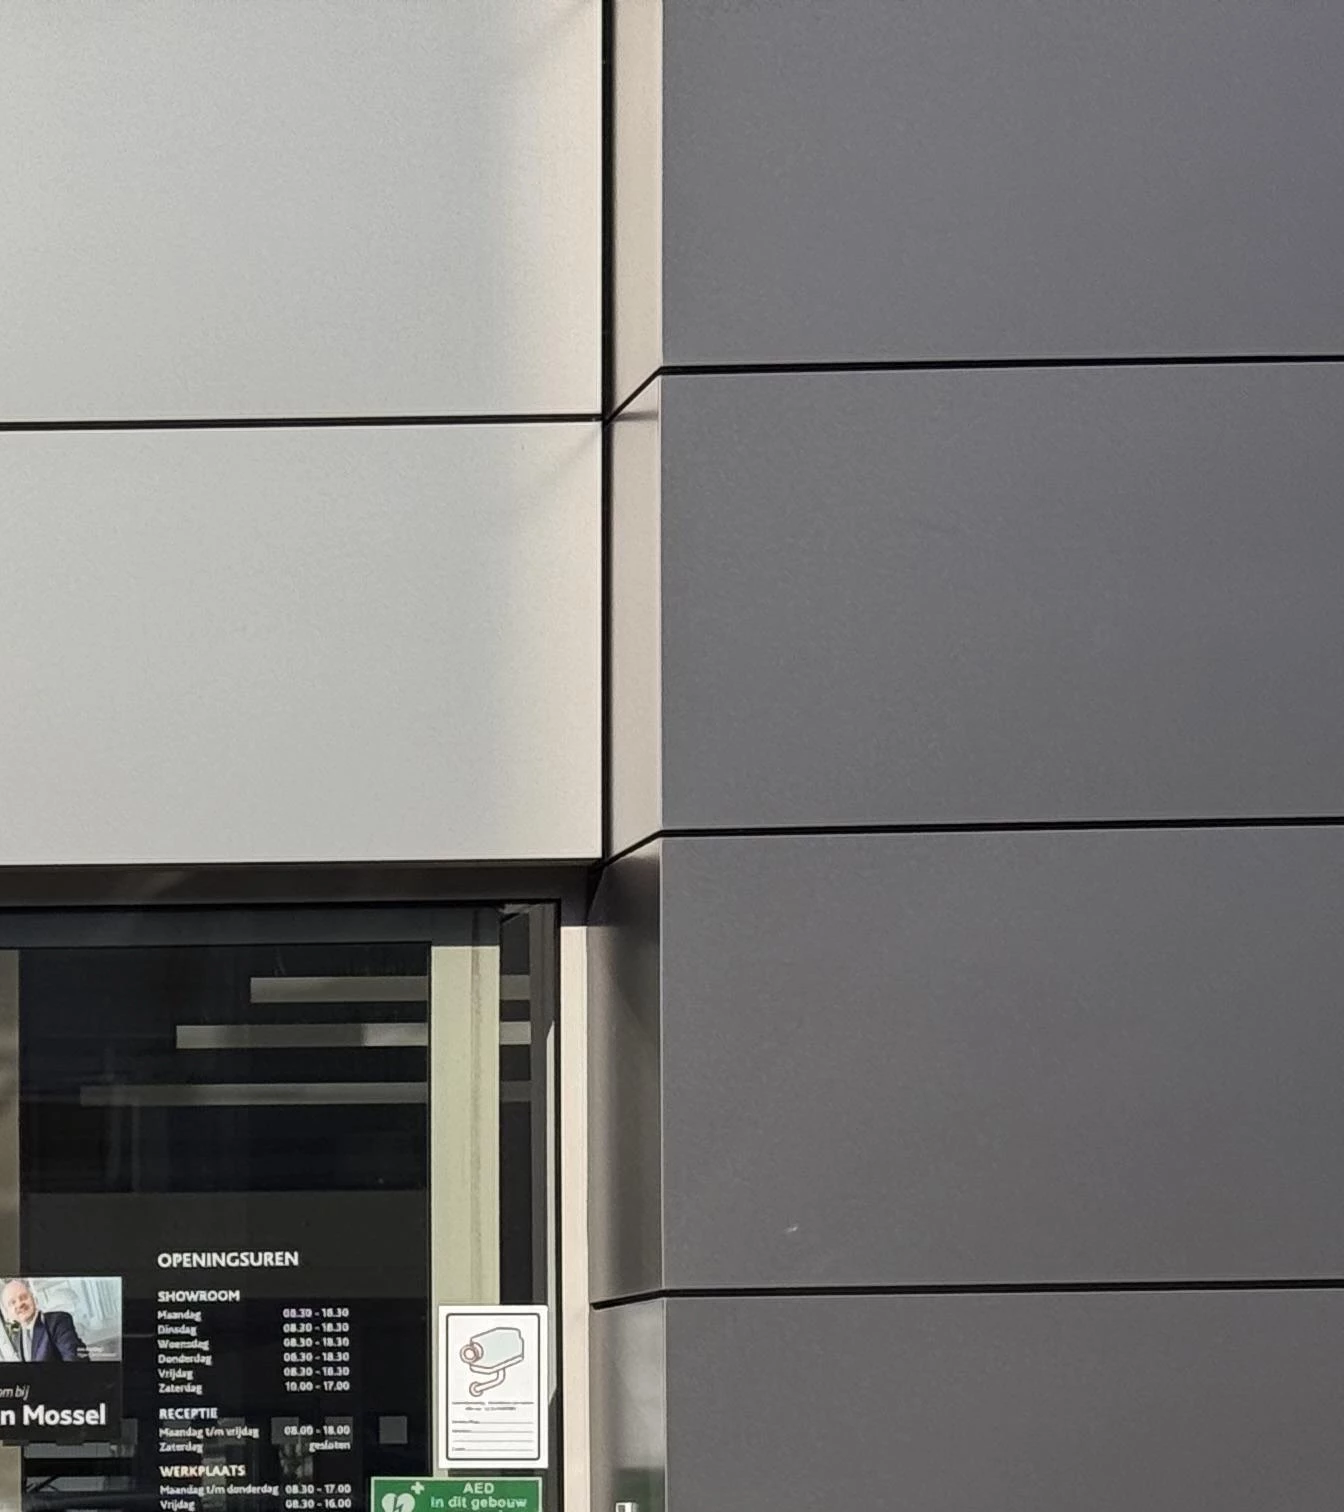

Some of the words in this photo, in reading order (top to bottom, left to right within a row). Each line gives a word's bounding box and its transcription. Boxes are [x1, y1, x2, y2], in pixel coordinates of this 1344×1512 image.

[157, 1251, 299, 1268] OPENINGSUREN
[157, 1290, 240, 1303] SHOWROOM
[157, 1309, 202, 1322] Maandag
[157, 1324, 197, 1336] Dinsdag
[157, 1339, 209, 1350] Woensdag
[157, 1353, 212, 1365] Donderdag
[158, 1368, 193, 1381] Vrijdag
[15, 1385, 30, 1400] bij
[158, 1383, 203, 1395] Zaterdag
[23, 1403, 106, 1426] Mossel
[159, 1408, 218, 1420] RECEPTIE
[159, 1427, 203, 1439] Maandag
[159, 1442, 204, 1454] Zaterdag
[160, 1465, 246, 1478] WERKPLAATS
[160, 1485, 204, 1497] Maandag
[323, 1483, 351, 1494] 17.00
[463, 1482, 495, 1494] AED
[160, 1500, 195, 1512] Vrijdag
[448, 1496, 467, 1508] dit
[471, 1496, 527, 1510] gebouw
